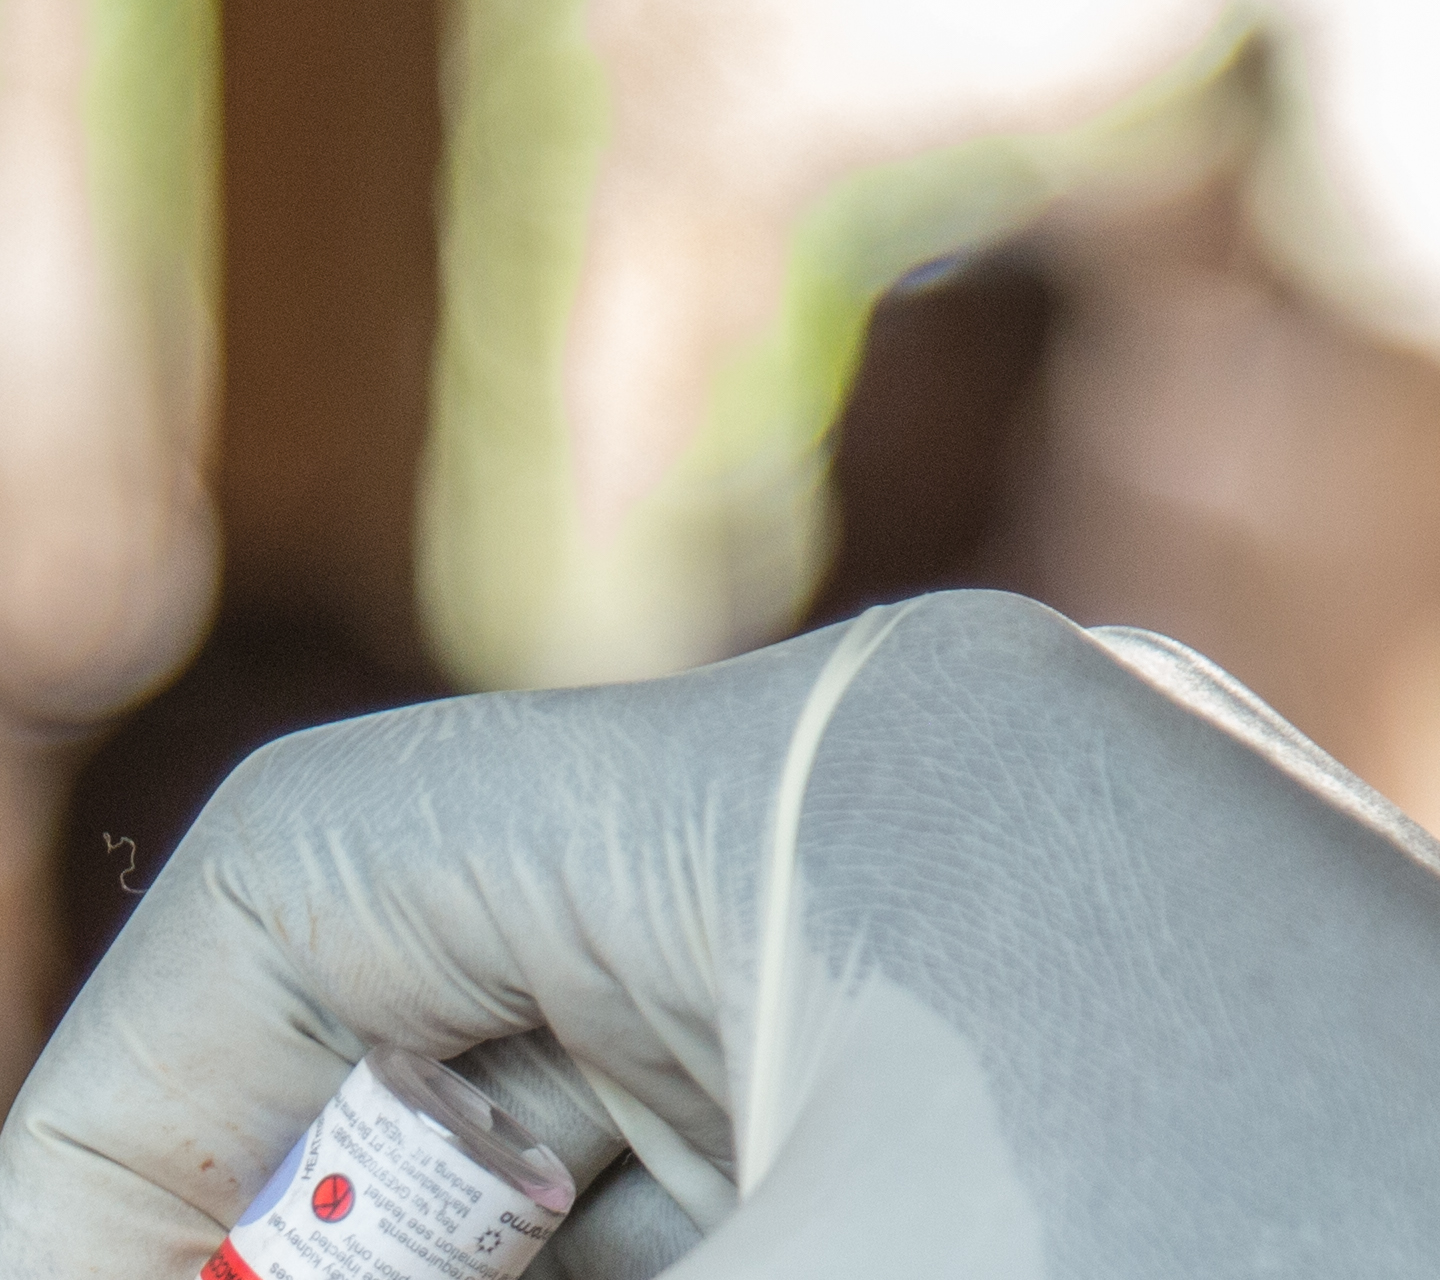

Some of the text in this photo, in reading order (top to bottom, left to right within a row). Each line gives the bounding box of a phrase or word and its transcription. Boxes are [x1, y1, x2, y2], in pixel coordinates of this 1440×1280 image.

[367, 1134, 385, 1152] PT
[435, 1159, 482, 1203] Bandung,
[363, 1184, 404, 1223] leaflet
[267, 1216, 285, 1232] cell
[407, 1220, 433, 1240] see
[283, 1227, 321, 1268] kidney
[308, 1229, 361, 1277] injected
[342, 1233, 372, 1261] only
[379, 1219, 463, 1280] requirements
